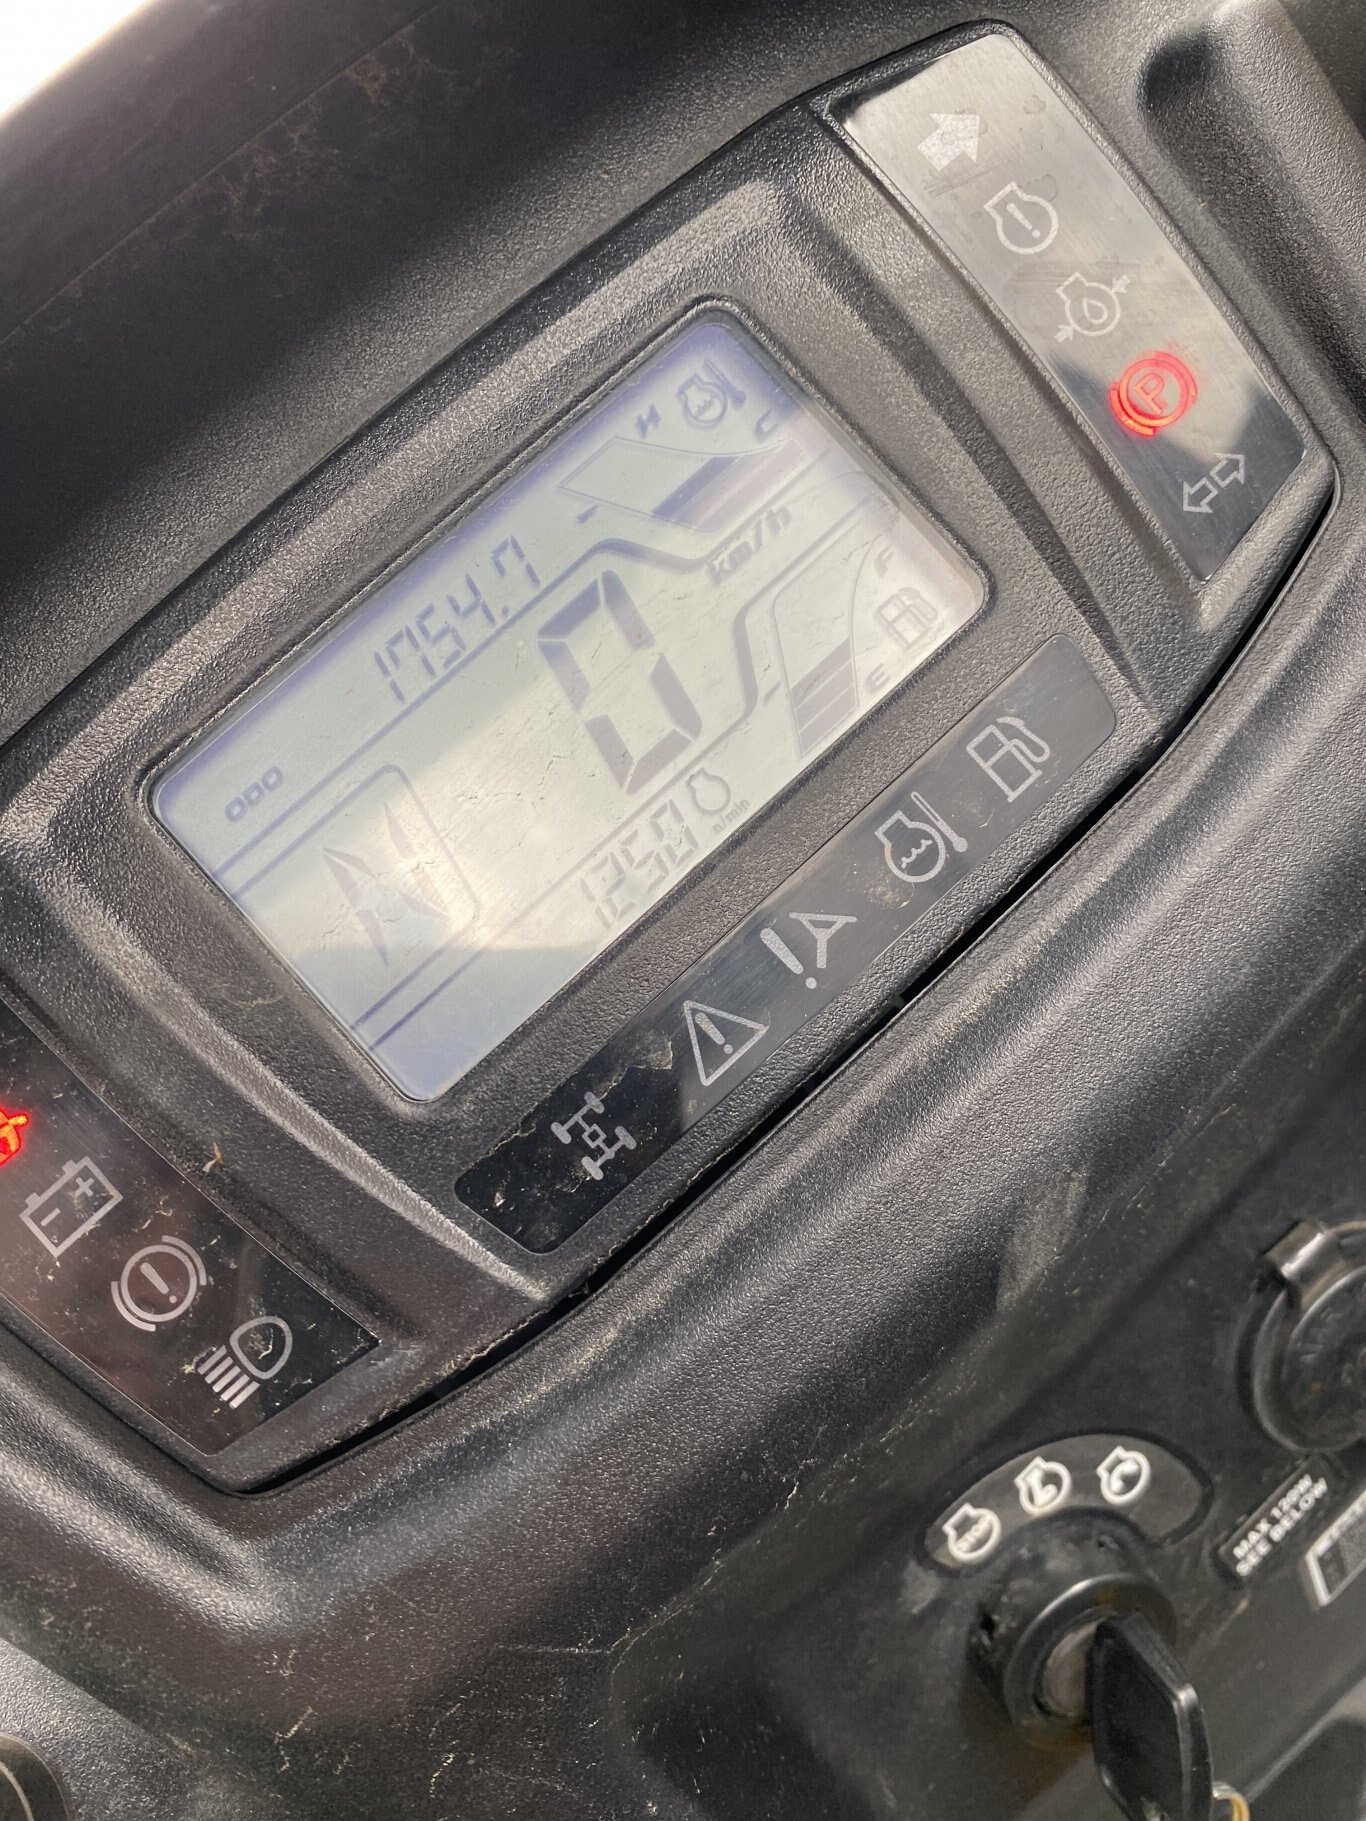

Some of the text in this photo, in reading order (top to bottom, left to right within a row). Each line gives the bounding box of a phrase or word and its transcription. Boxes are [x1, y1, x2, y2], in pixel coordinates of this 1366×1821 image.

[635, 403, 662, 438] H
[754, 409, 778, 442] C
[706, 504, 793, 588] km/h
[873, 545, 895, 577] F
[374, 535, 541, 704] 1754.7
[864, 662, 891, 693] E
[224, 766, 283, 823] ODO
[1233, 1518, 1273, 1560] MAX
[1236, 1477, 1328, 1577] SEE BELOW
